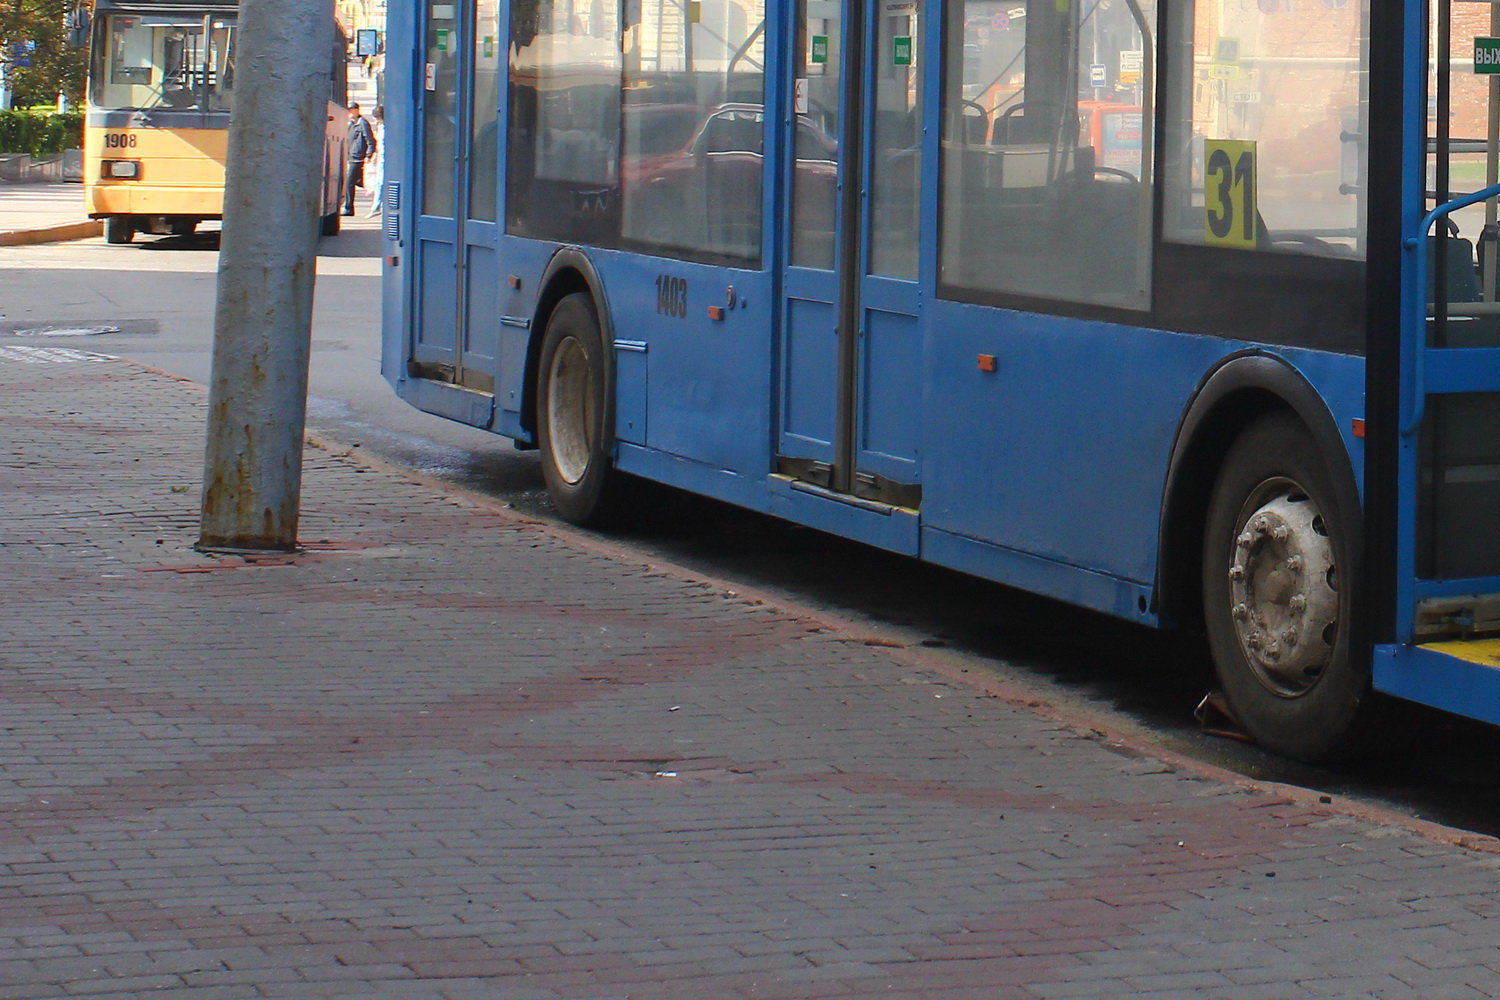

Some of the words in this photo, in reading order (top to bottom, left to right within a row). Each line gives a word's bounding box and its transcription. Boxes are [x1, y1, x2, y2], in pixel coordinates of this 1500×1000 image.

[103, 133, 137, 148] 1908
[1207, 149, 1253, 241] 31
[655, 273, 688, 319] 1403
